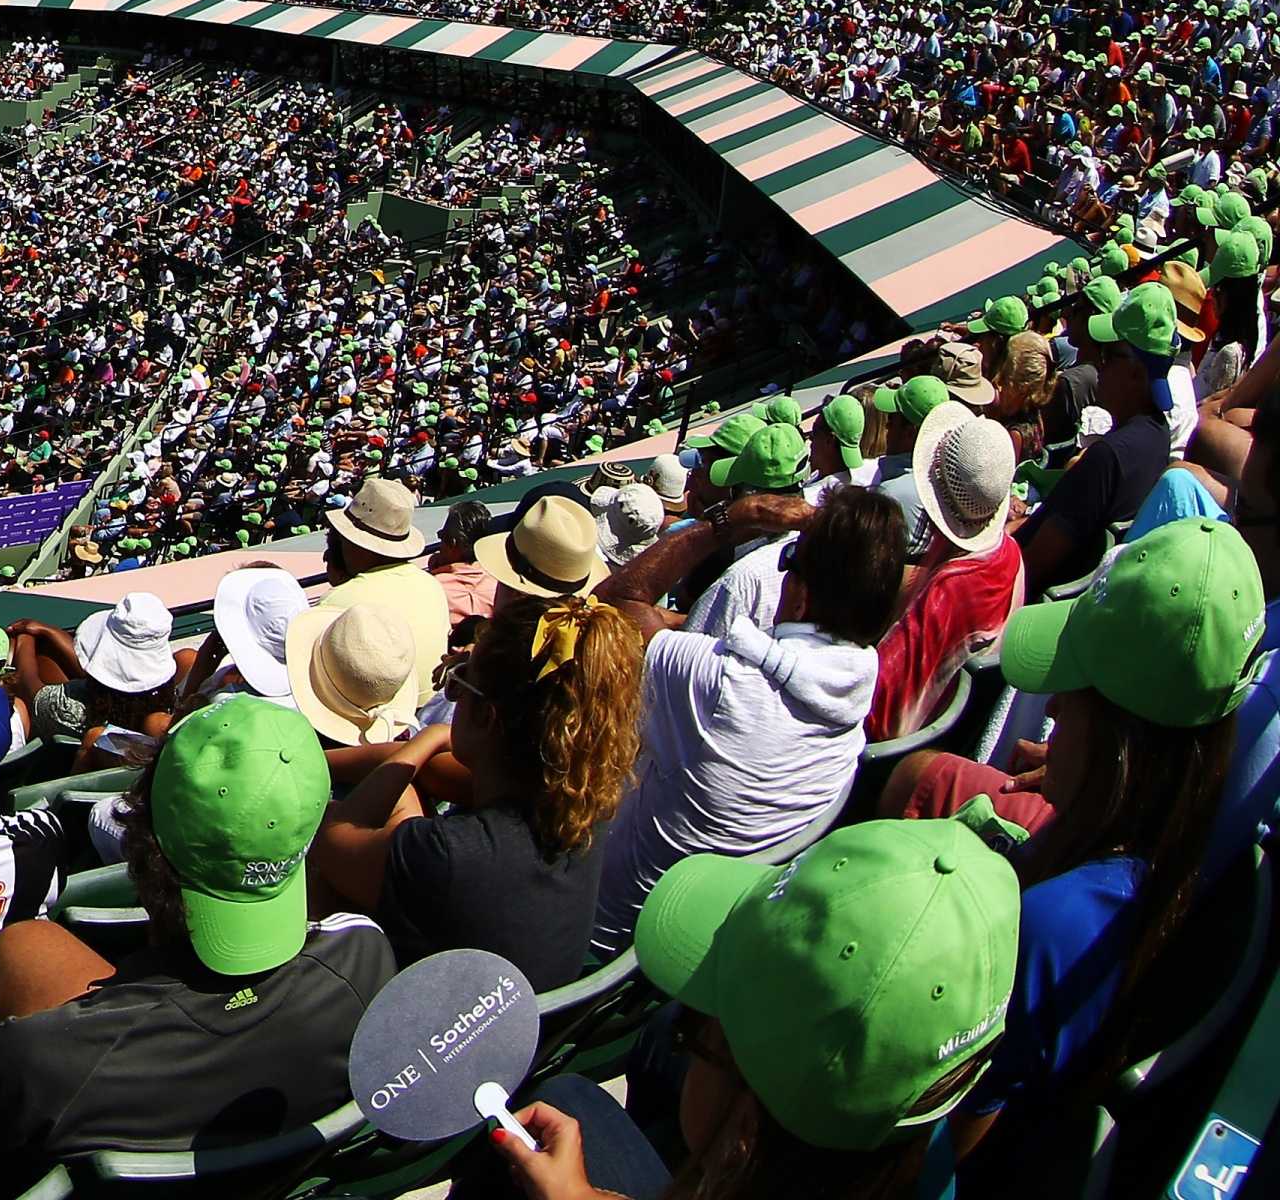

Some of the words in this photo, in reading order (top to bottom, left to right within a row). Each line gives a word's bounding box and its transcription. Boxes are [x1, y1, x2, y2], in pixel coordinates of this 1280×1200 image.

[246, 858, 290, 873] SONY
[224, 996, 258, 1010] adidas
[370, 1064, 422, 1110] ONE
[430, 976, 516, 1054] Sotheby's
[442, 1014, 498, 1064] INTERNATIONAL
[497, 990, 522, 1014] REALTY
[938, 1013, 990, 1060] Miami
